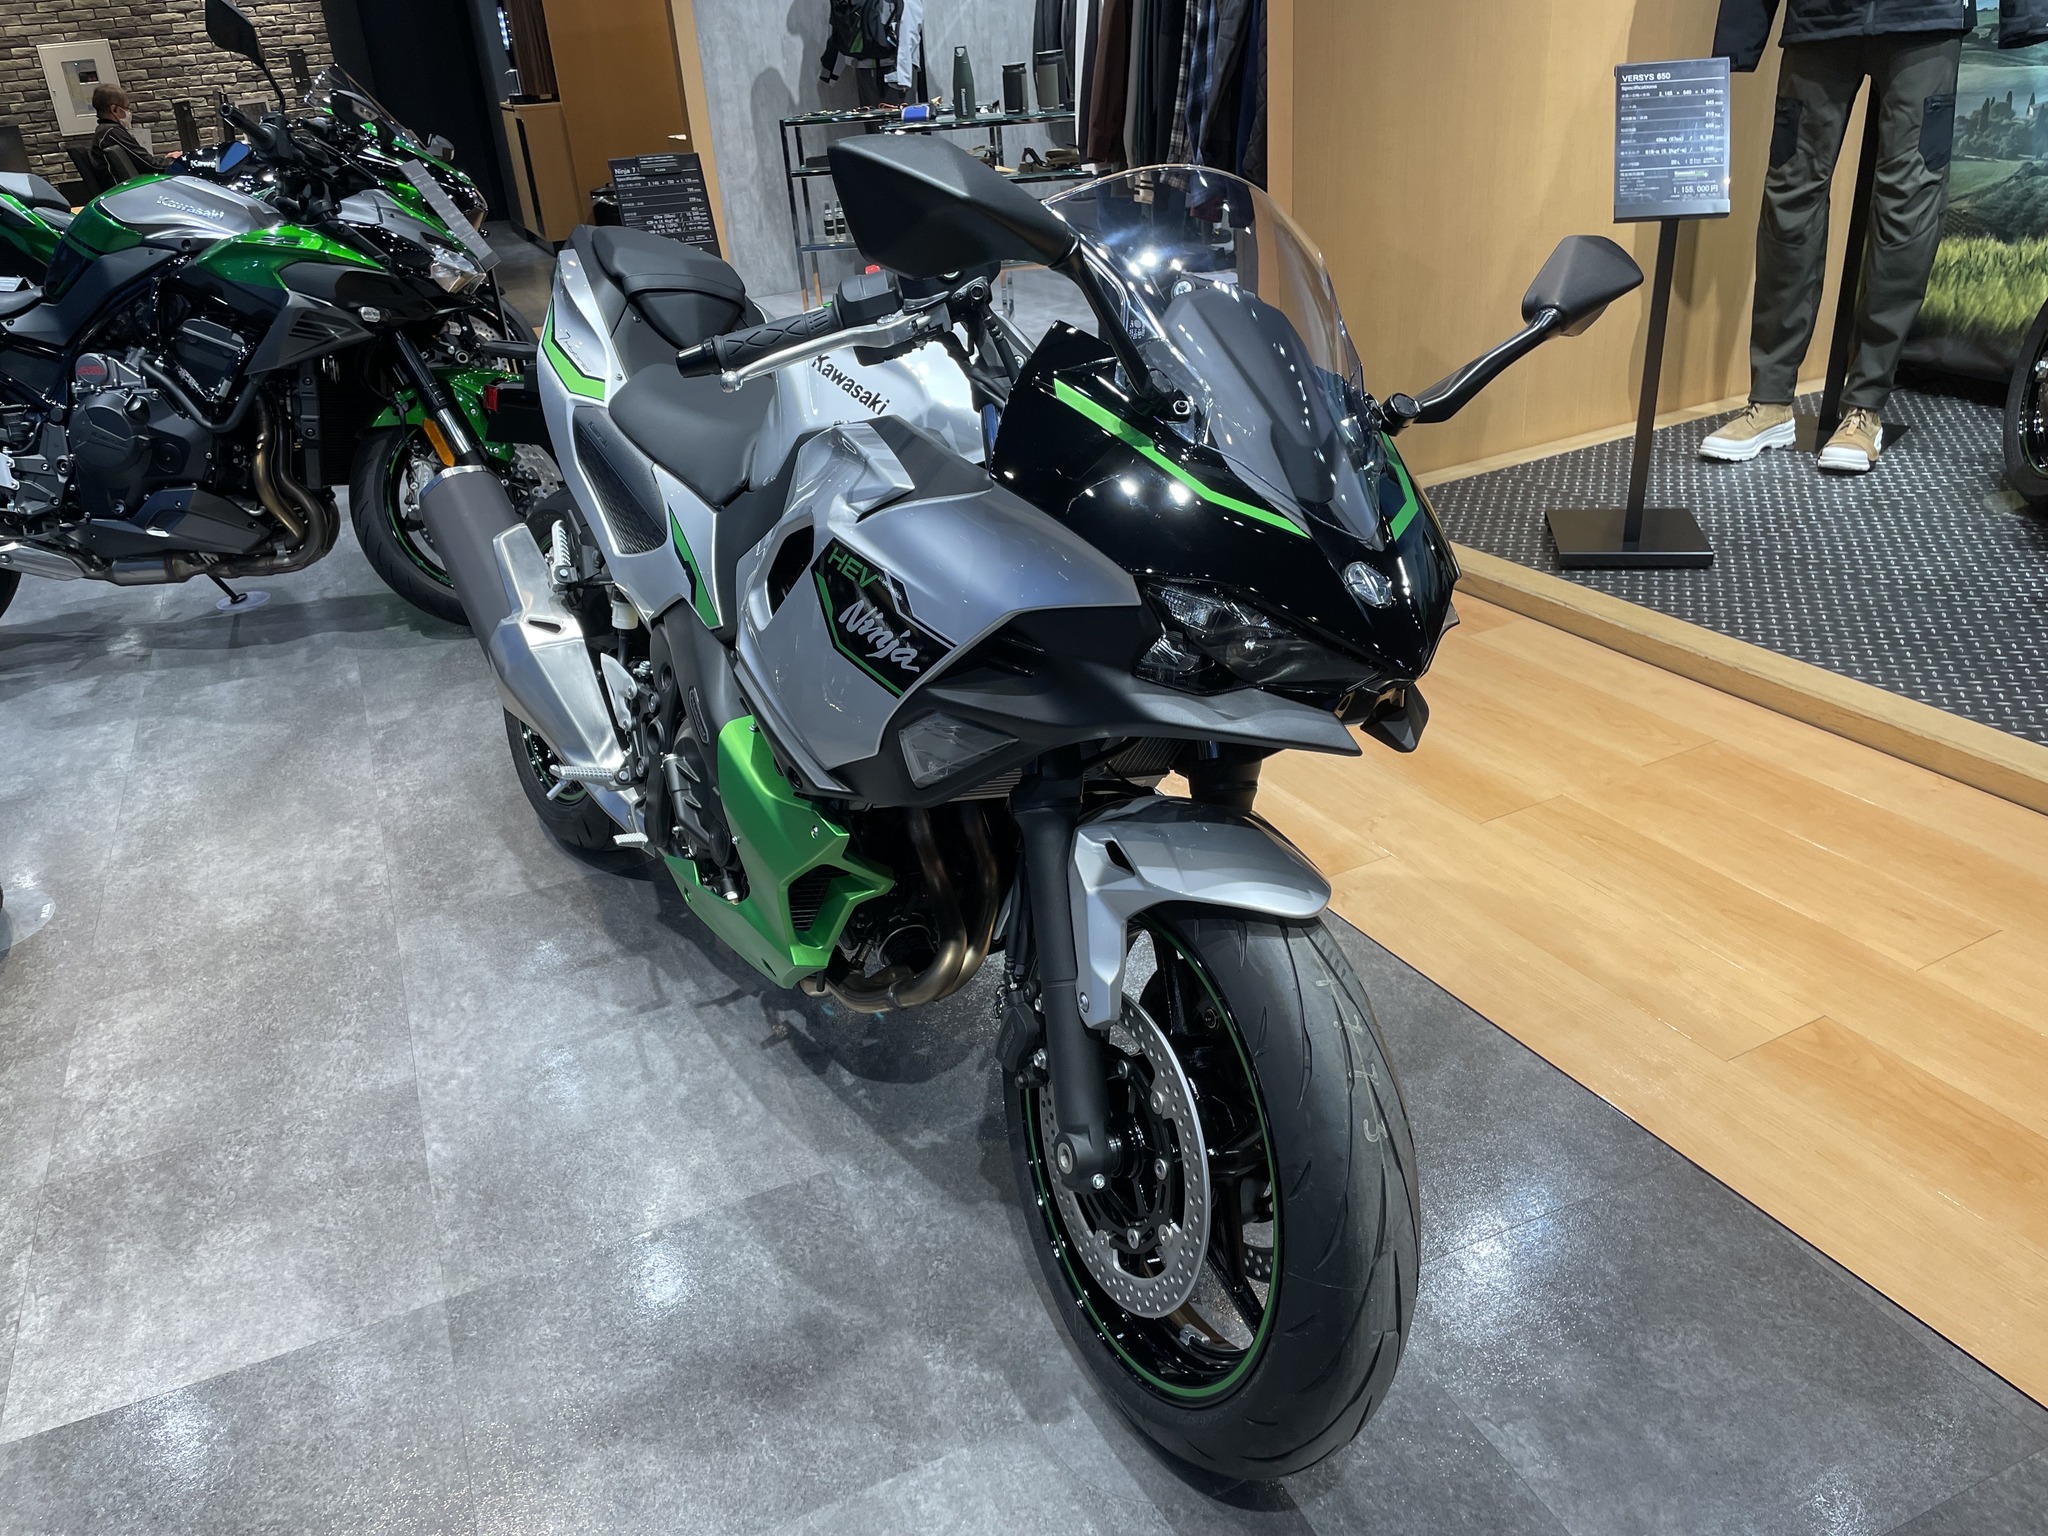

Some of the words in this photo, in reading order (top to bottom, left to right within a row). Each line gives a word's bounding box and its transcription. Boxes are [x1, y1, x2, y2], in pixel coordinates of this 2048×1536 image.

[1622, 73, 1655, 82] VERSYS
[1656, 72, 1671, 80] 650
[614, 167, 631, 175] Ninja
[631, 166, 636, 174] 7
[157, 195, 225, 220] Kawasaki
[811, 354, 890, 416] Kawasaki
[827, 546, 879, 589] HEV
[838, 599, 920, 673] Ninja
